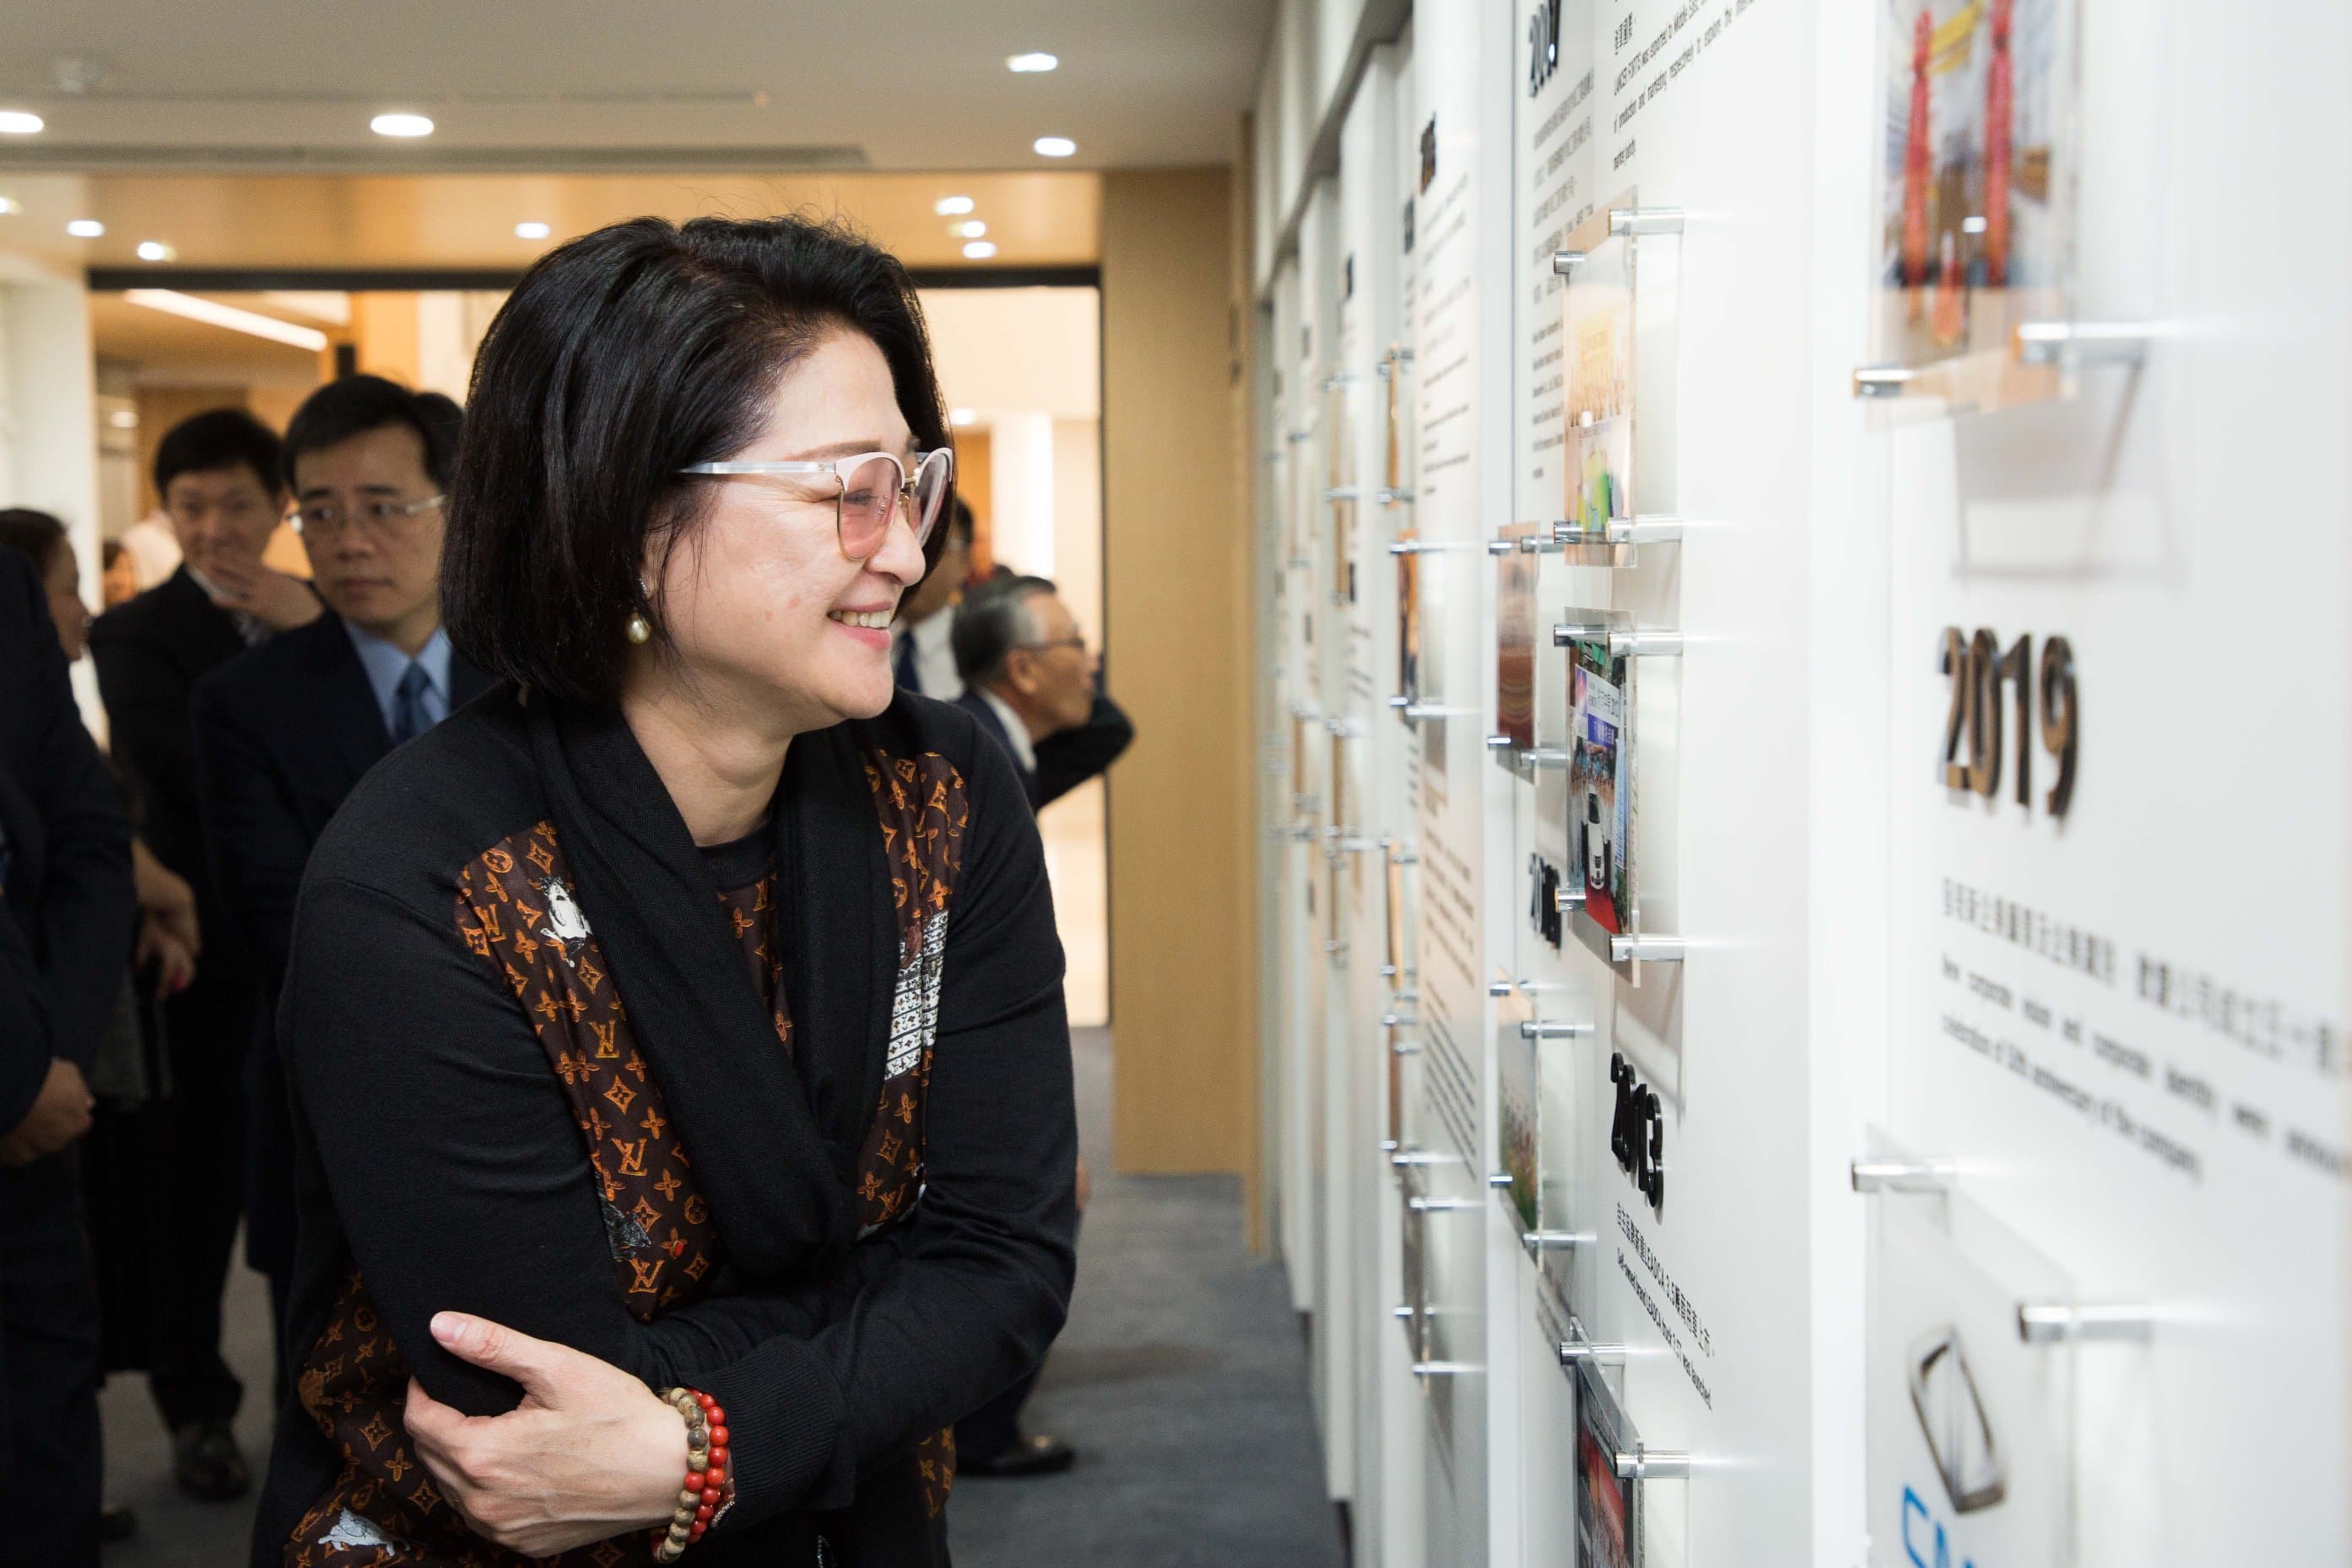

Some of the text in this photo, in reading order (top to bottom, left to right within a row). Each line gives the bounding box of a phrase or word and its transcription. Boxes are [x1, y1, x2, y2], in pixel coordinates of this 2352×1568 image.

[1939, 626, 2079, 820] 2019
[611, 1138, 648, 1176] LV
[1610, 1052, 1664, 1207] 2013
[629, 1257, 665, 1293] LV
